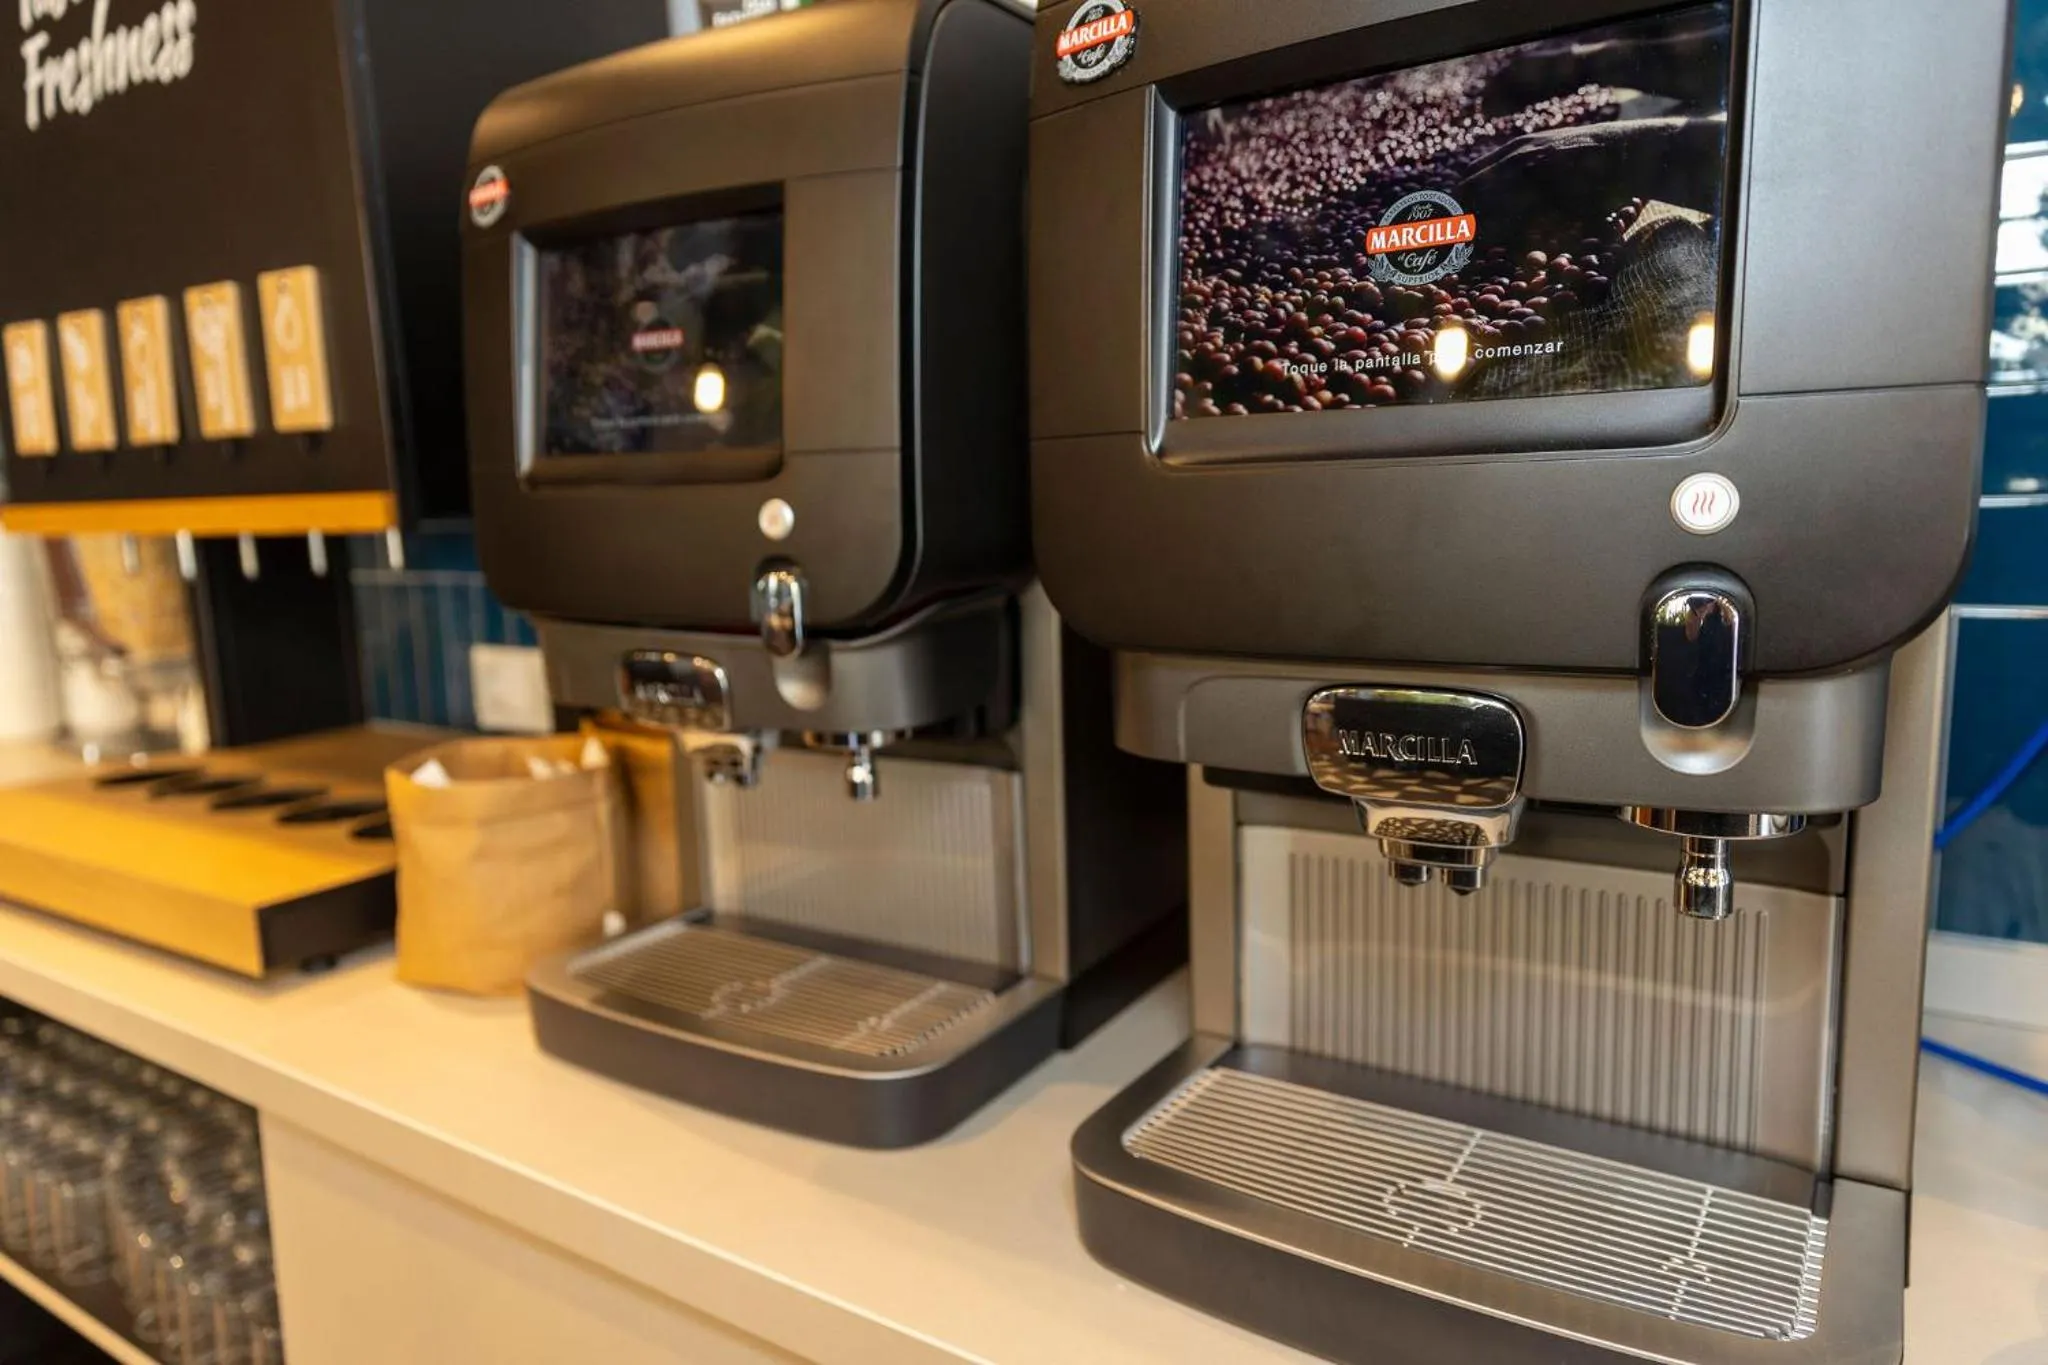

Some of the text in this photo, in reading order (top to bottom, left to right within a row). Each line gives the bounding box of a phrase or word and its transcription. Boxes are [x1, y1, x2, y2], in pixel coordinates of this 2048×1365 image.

[1059, 13, 1127, 49] MARCILLA
[20, 0, 197, 132] Freshness
[1407, 208, 1434, 221] 1907
[1371, 219, 1471, 251] MARCILLA
[1404, 249, 1439, 272] Café
[1282, 361, 1328, 376] Toque
[1334, 358, 1348, 371] la
[1355, 352, 1421, 371] pantalla
[1474, 340, 1564, 359] comenzar
[1338, 729, 1478, 766] MARCILLA
